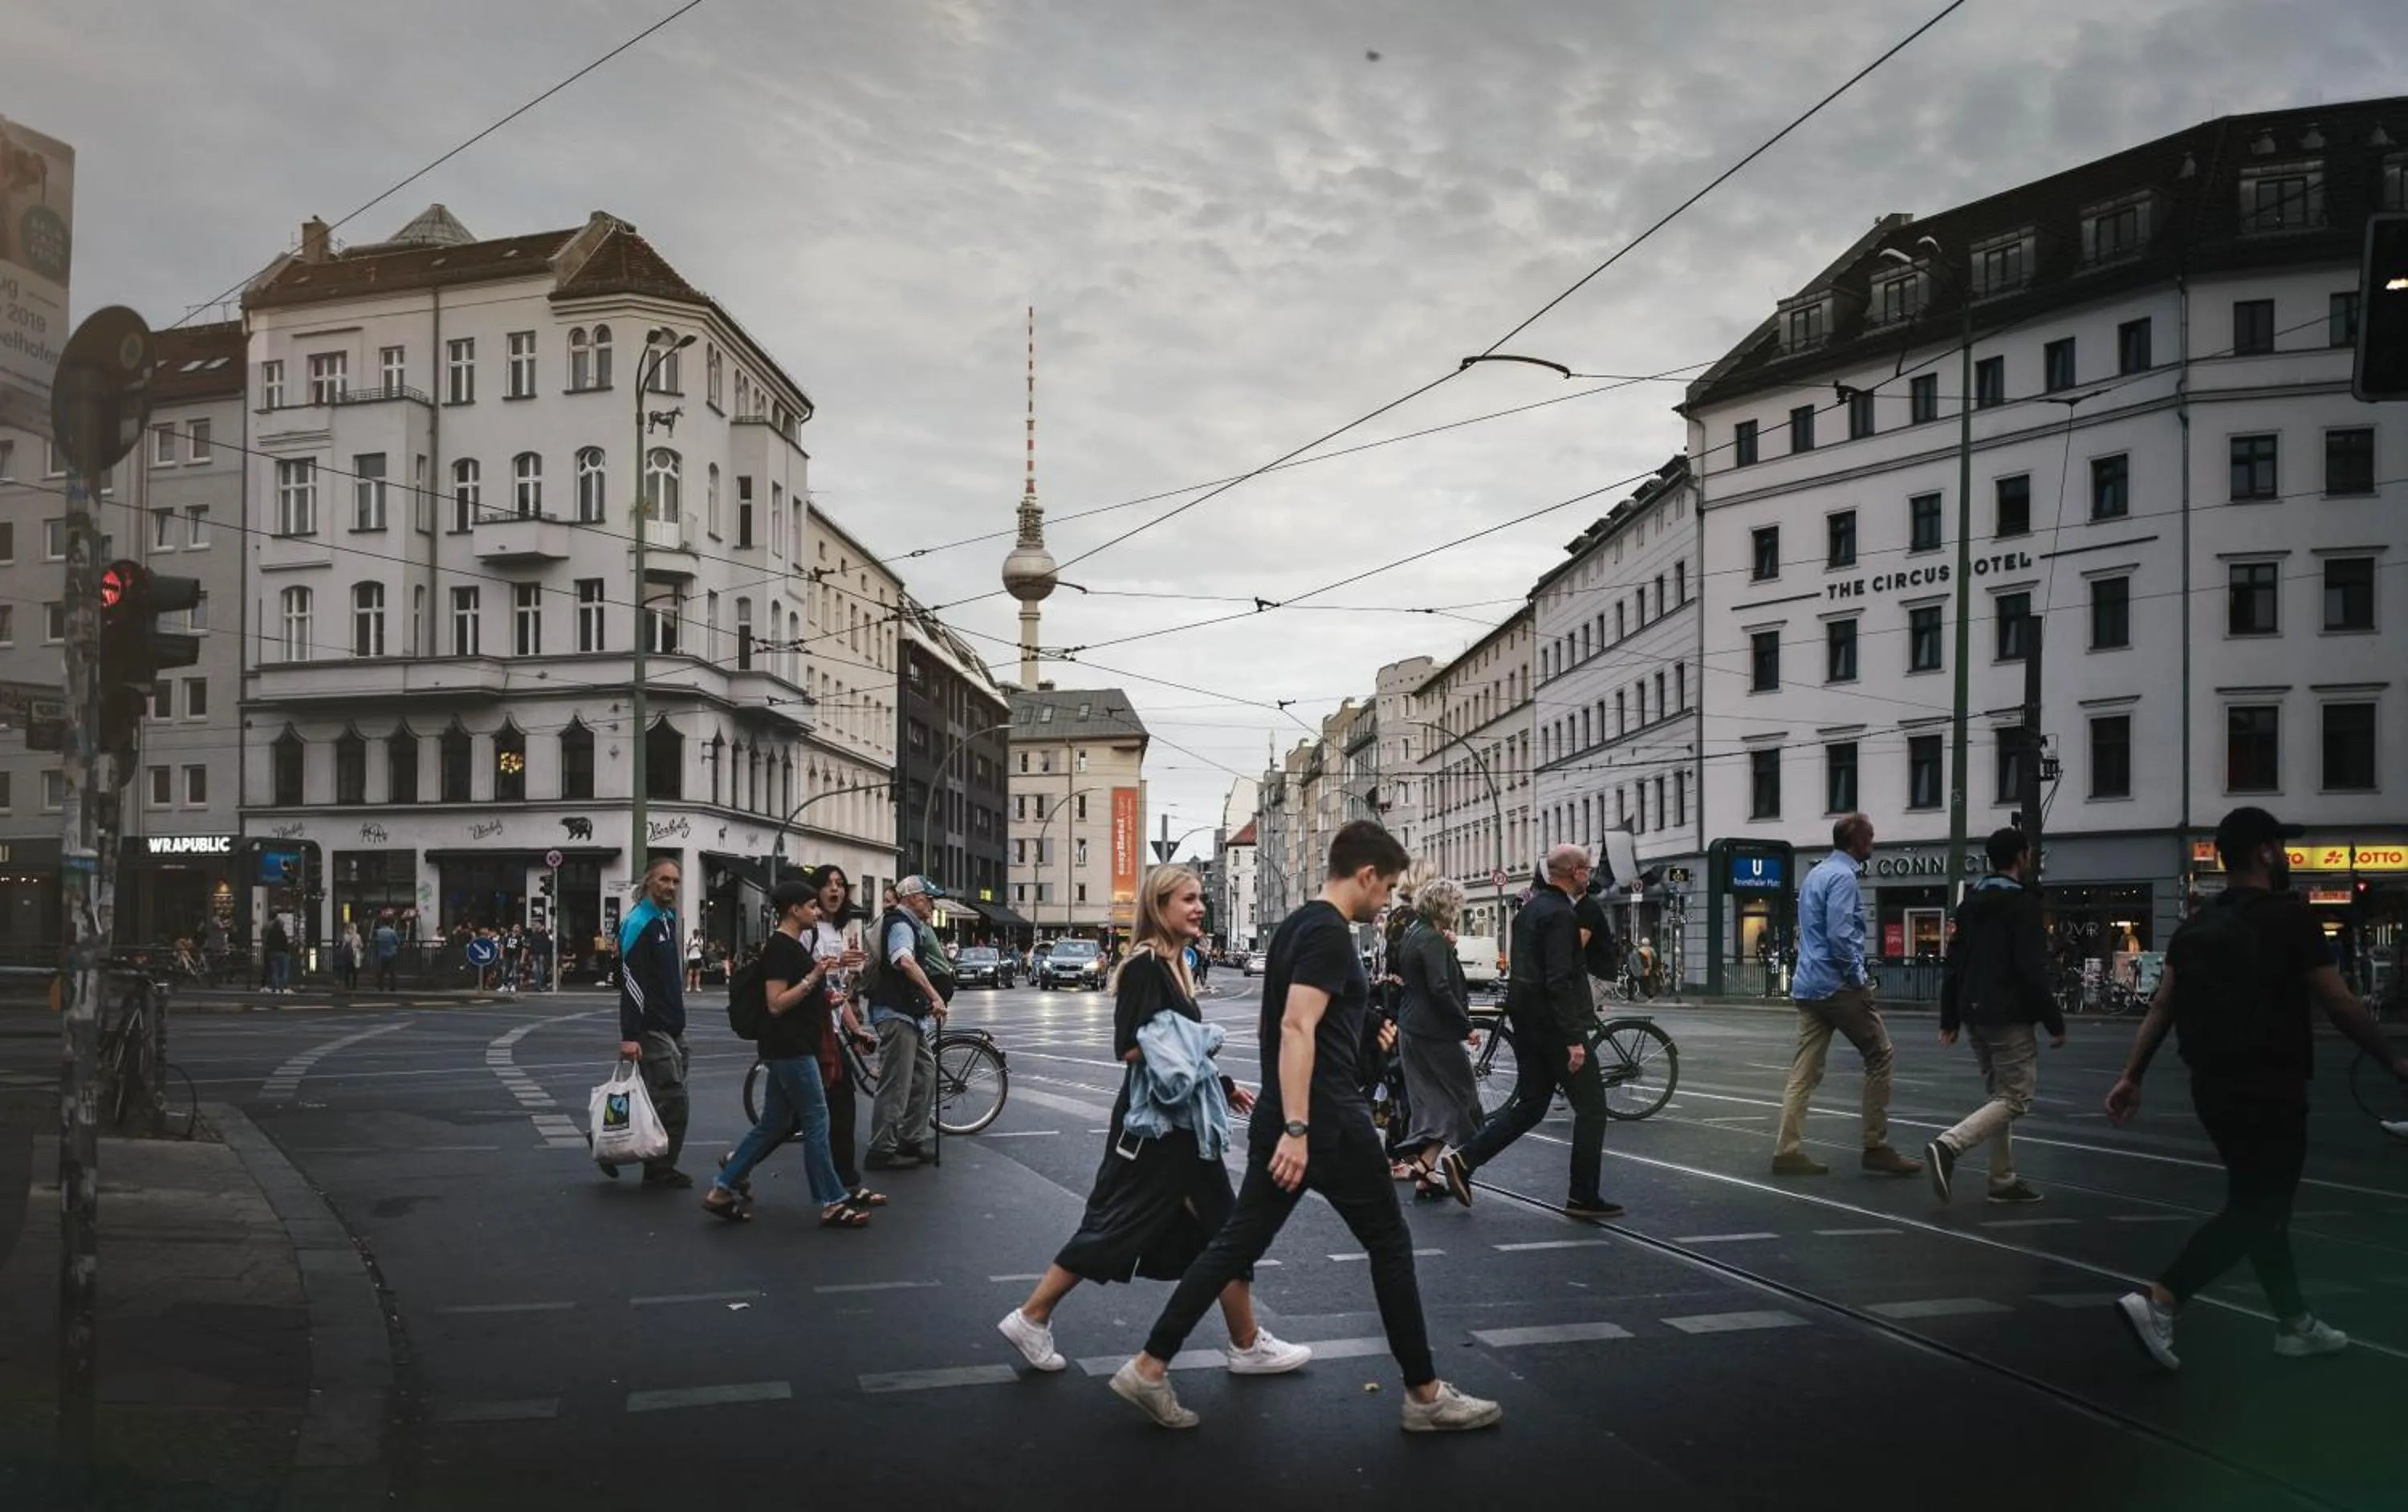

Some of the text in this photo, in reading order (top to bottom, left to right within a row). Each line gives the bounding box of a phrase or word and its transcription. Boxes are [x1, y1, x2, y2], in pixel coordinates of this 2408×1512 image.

[6, 302, 47, 332] 2019
[0, 330, 60, 365] elhofer
[1827, 552, 2032, 600] THE CIRCUS OTEL
[148, 836, 231, 853] WRAPUBLIC
[1751, 858, 1763, 876] U
[1877, 854, 1991, 875] CONNCT
